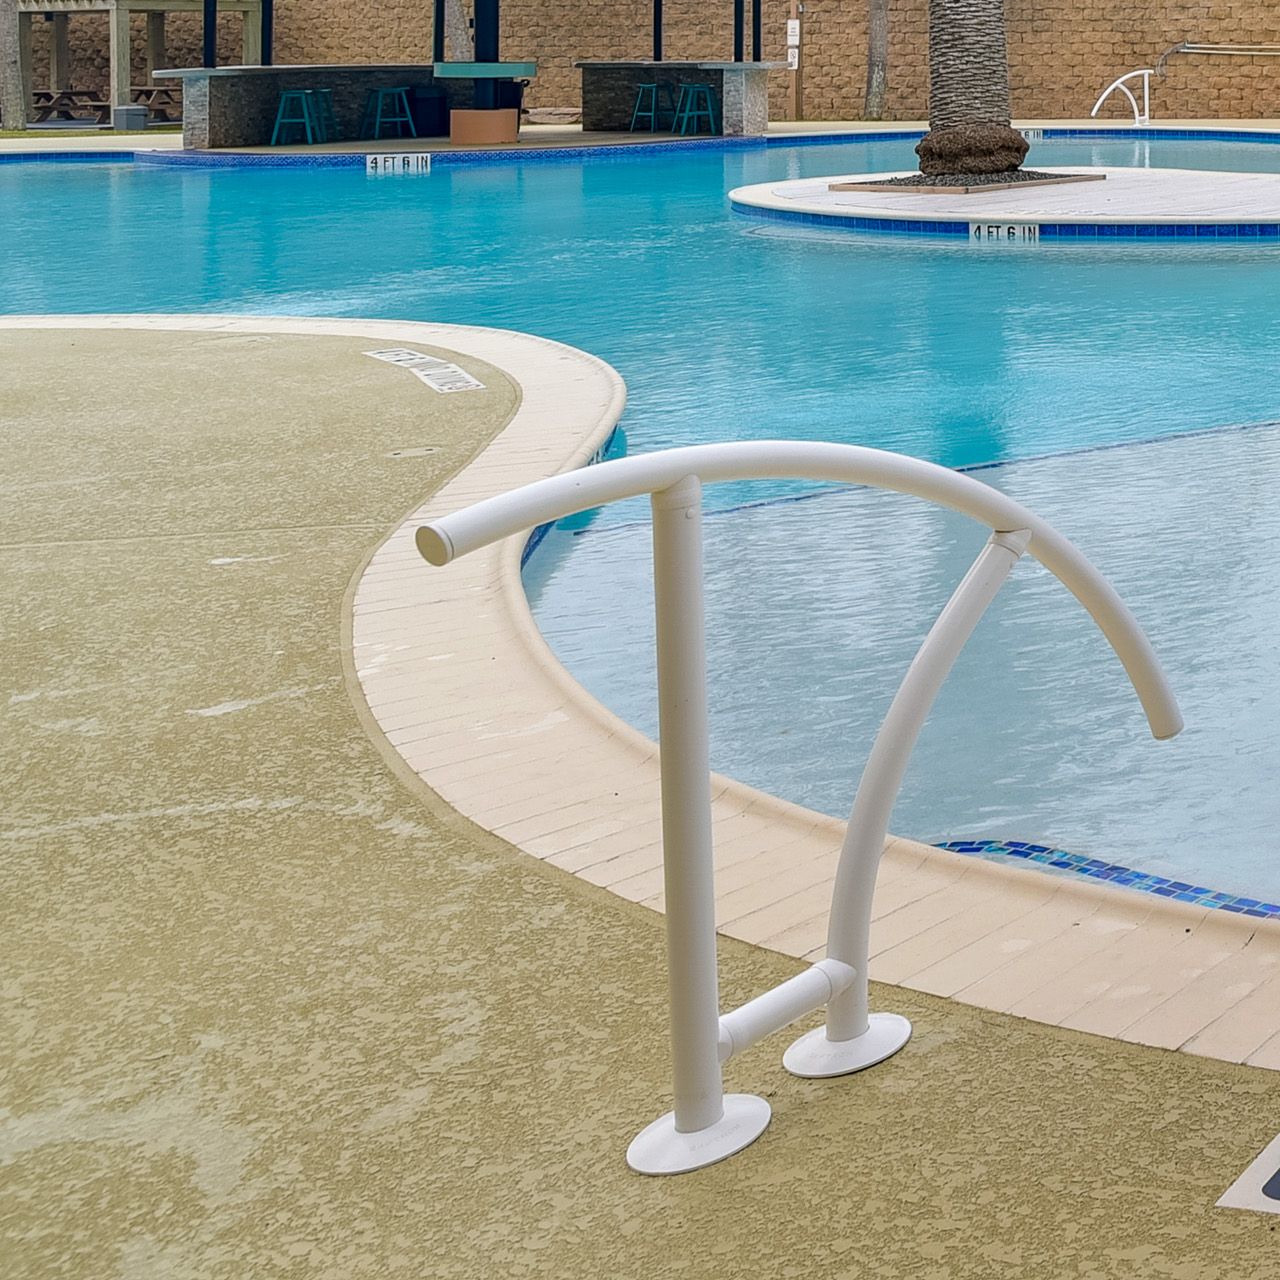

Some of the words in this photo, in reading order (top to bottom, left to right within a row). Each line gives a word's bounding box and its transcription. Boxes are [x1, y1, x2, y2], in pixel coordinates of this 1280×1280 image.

[384, 156, 396, 170] FT
[416, 155, 428, 170] IN
[987, 225, 1001, 239] FT
[1022, 226, 1036, 240] IN
